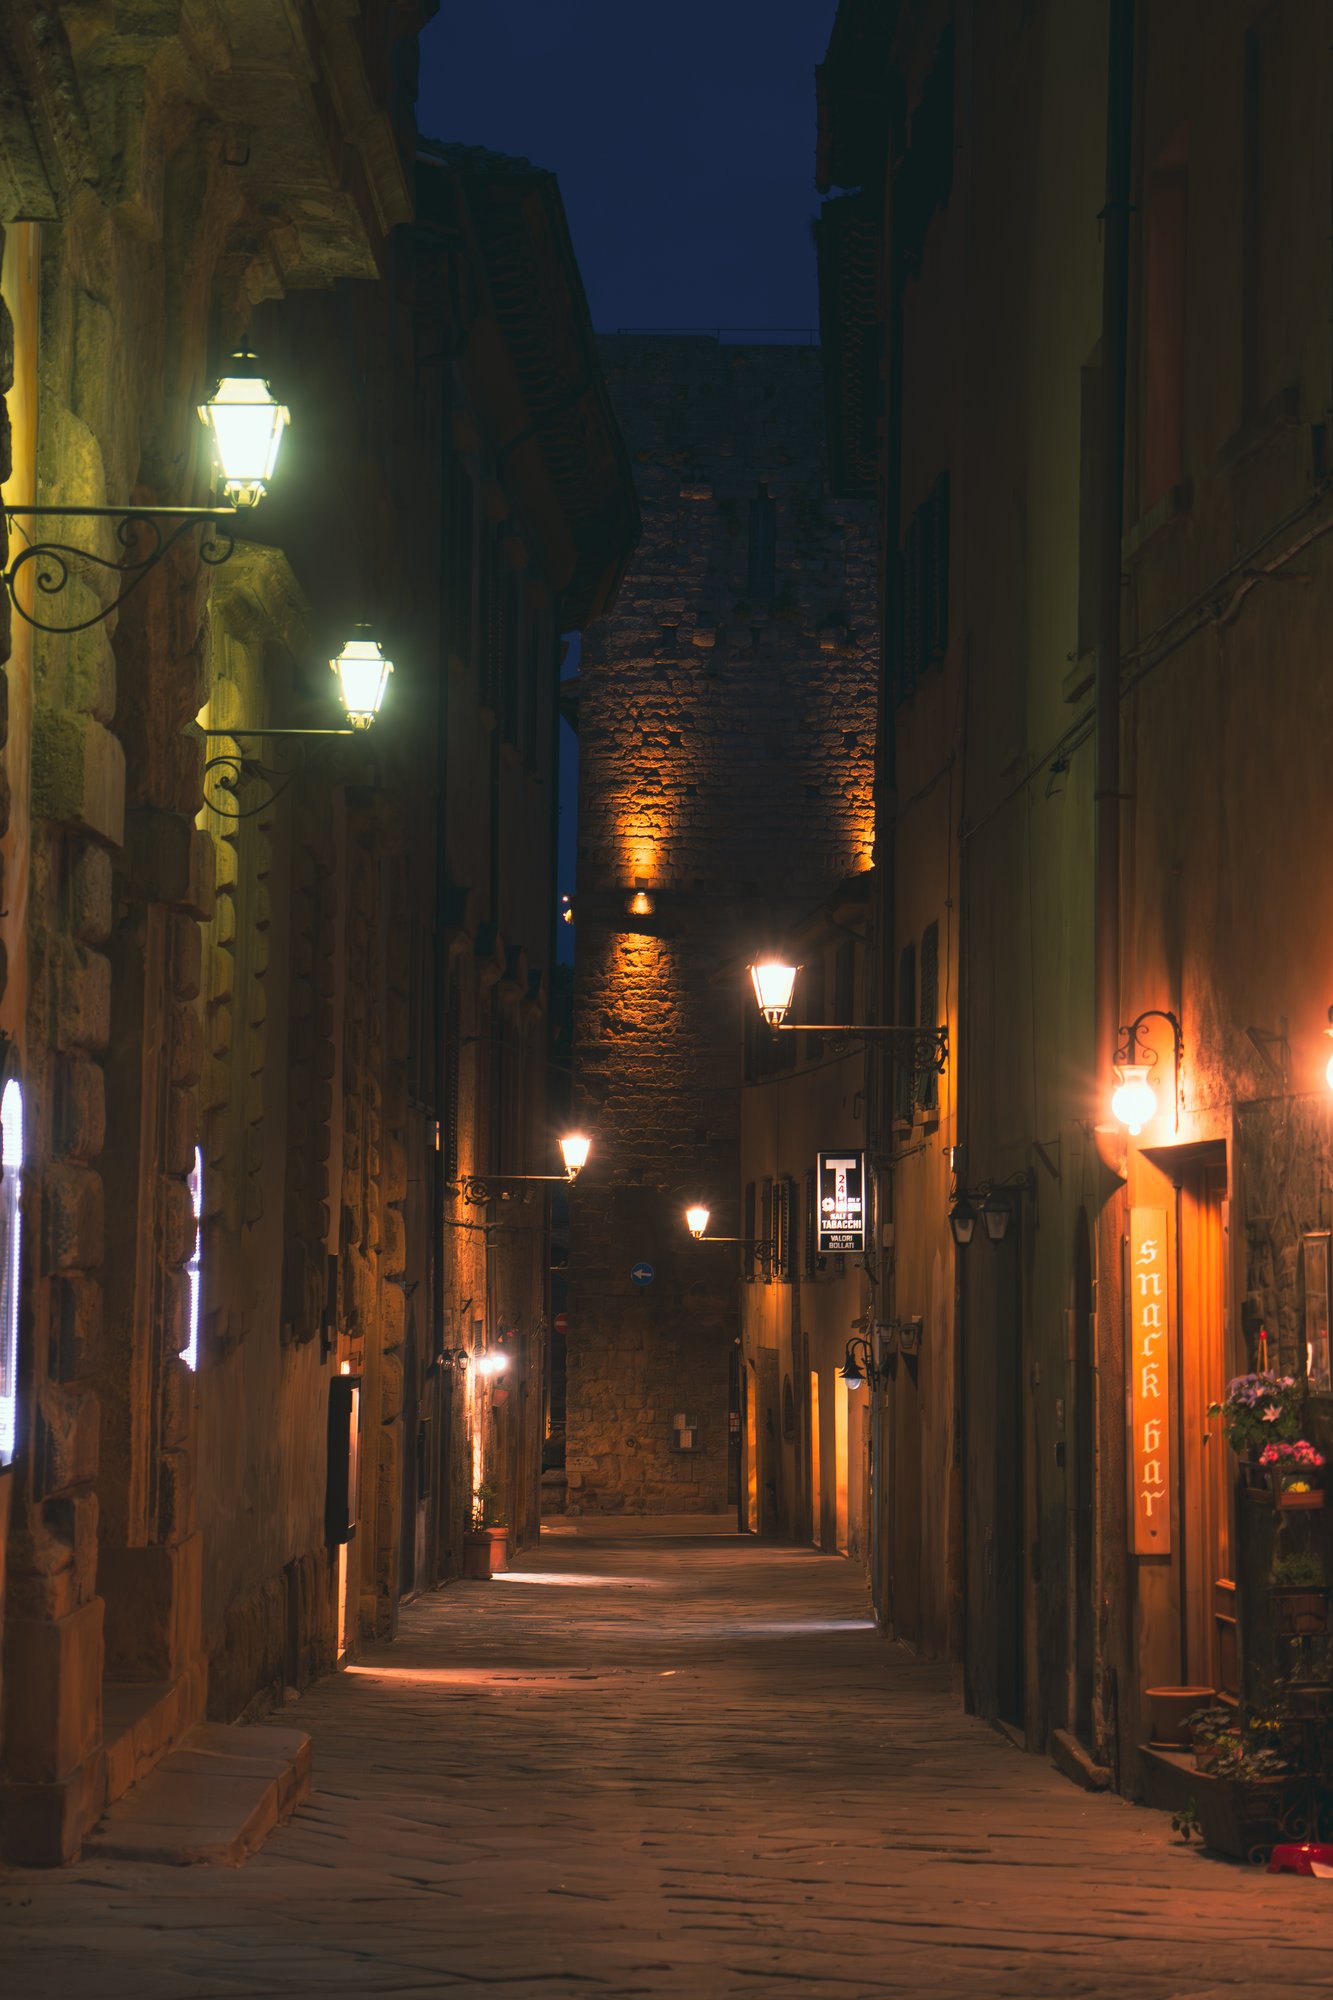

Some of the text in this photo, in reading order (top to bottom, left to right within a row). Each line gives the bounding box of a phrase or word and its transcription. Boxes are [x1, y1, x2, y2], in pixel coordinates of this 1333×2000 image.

[825, 1159, 856, 1212] T
[822, 1220, 862, 1229] TABACCHI
[1136, 1239, 1165, 1517] snack bar
